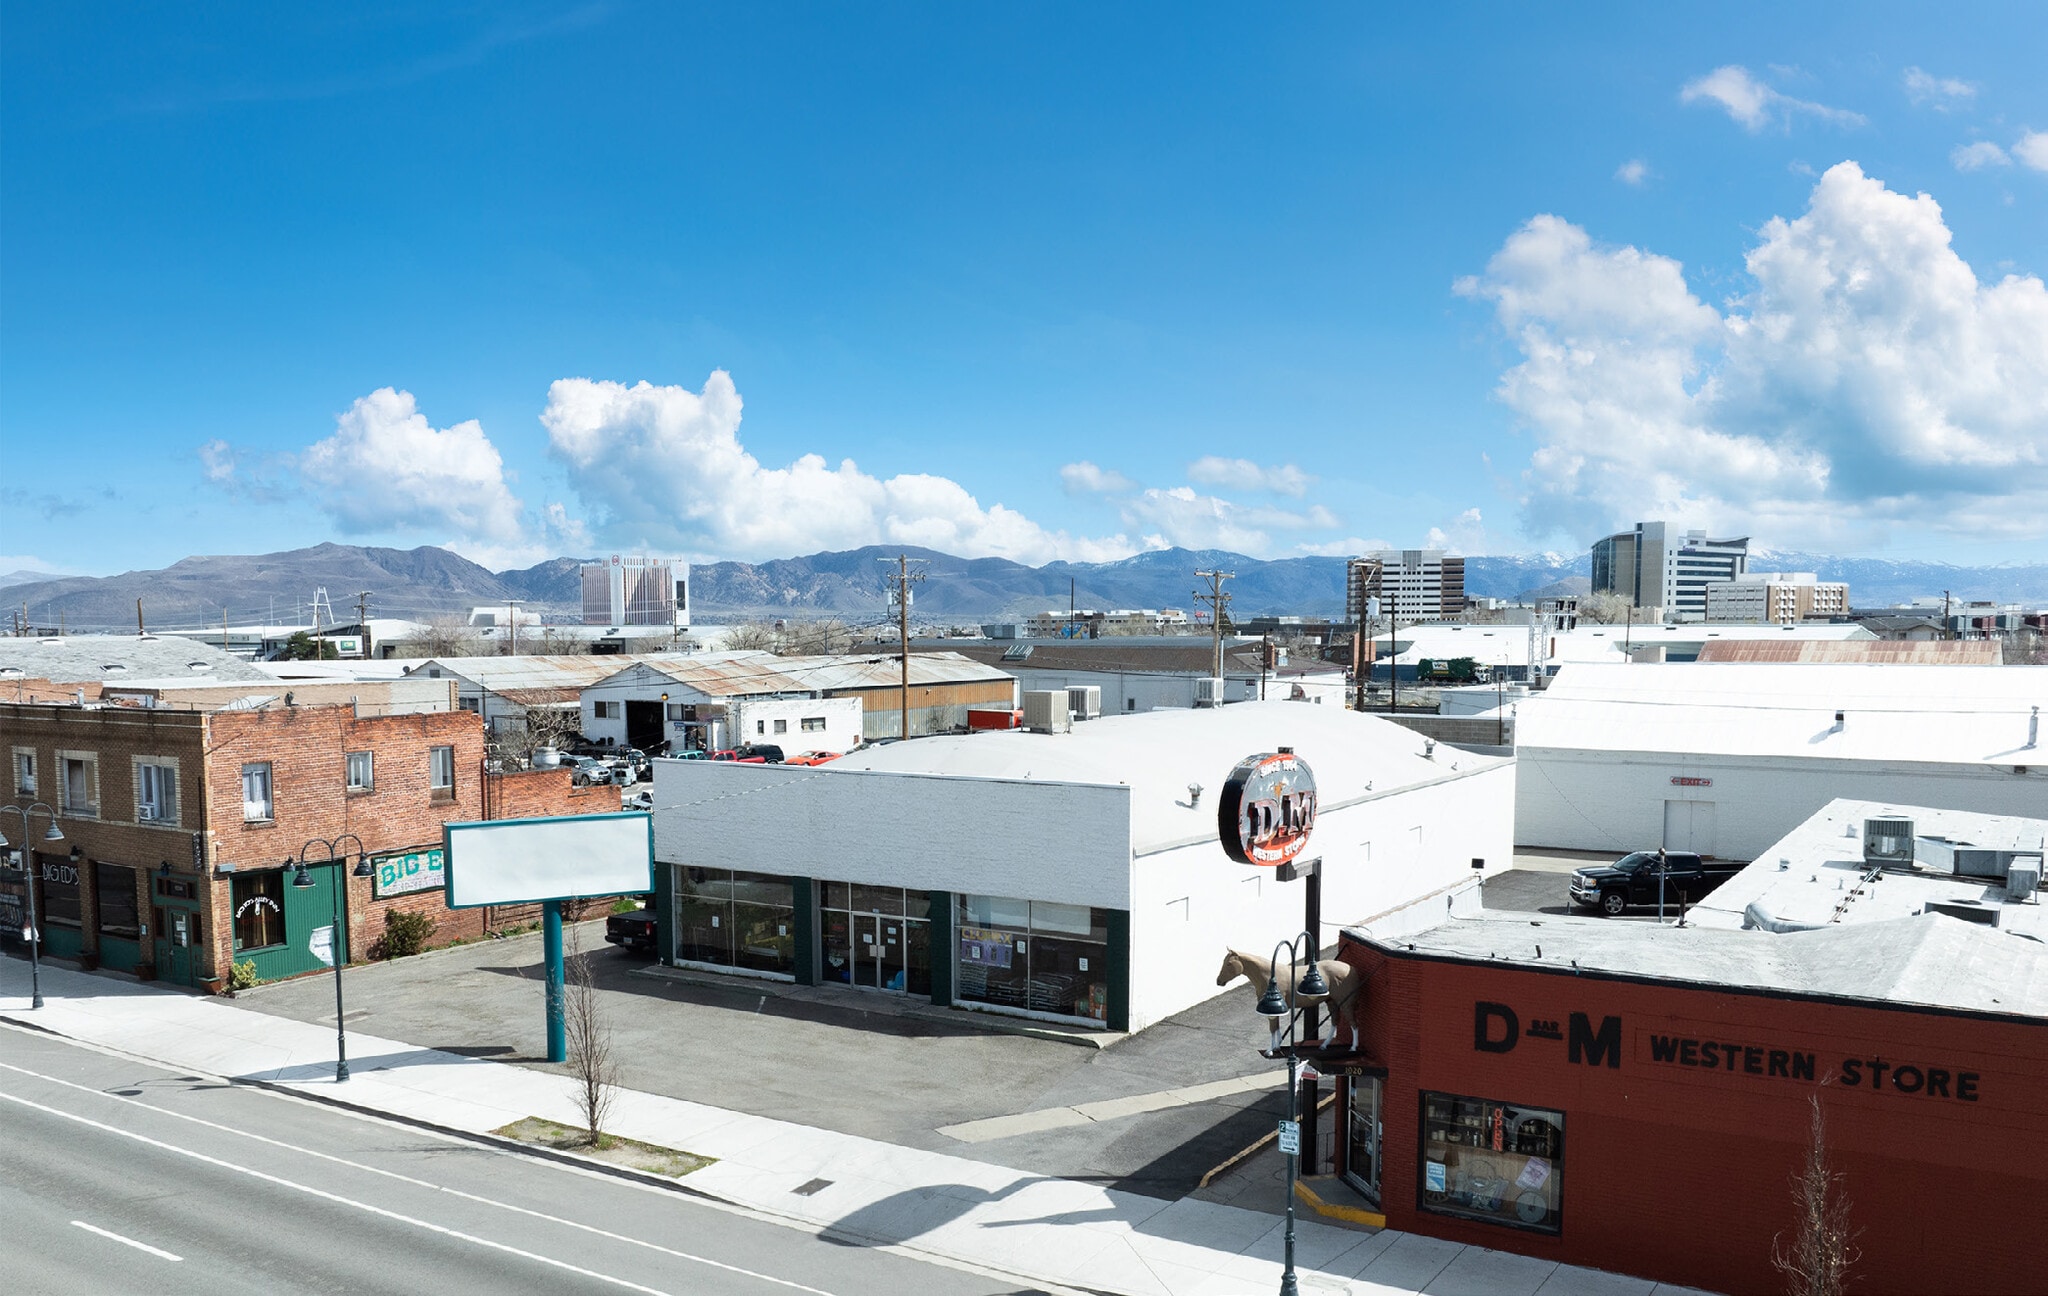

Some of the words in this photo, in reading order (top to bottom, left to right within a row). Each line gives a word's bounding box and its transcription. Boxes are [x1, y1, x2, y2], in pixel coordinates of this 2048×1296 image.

[1680, 777, 1701, 786] EXIT
[42, 863, 60, 882] BIG
[381, 853, 420, 888] BIG
[1475, 1001, 1520, 1053] D
[1531, 1019, 1560, 1033] BAR
[1568, 1011, 1622, 1069] M
[1651, 1034, 1815, 1081] WESTERN
[1839, 1058, 1981, 1101] STORE
[1493, 1107, 1504, 1152] OPEN
